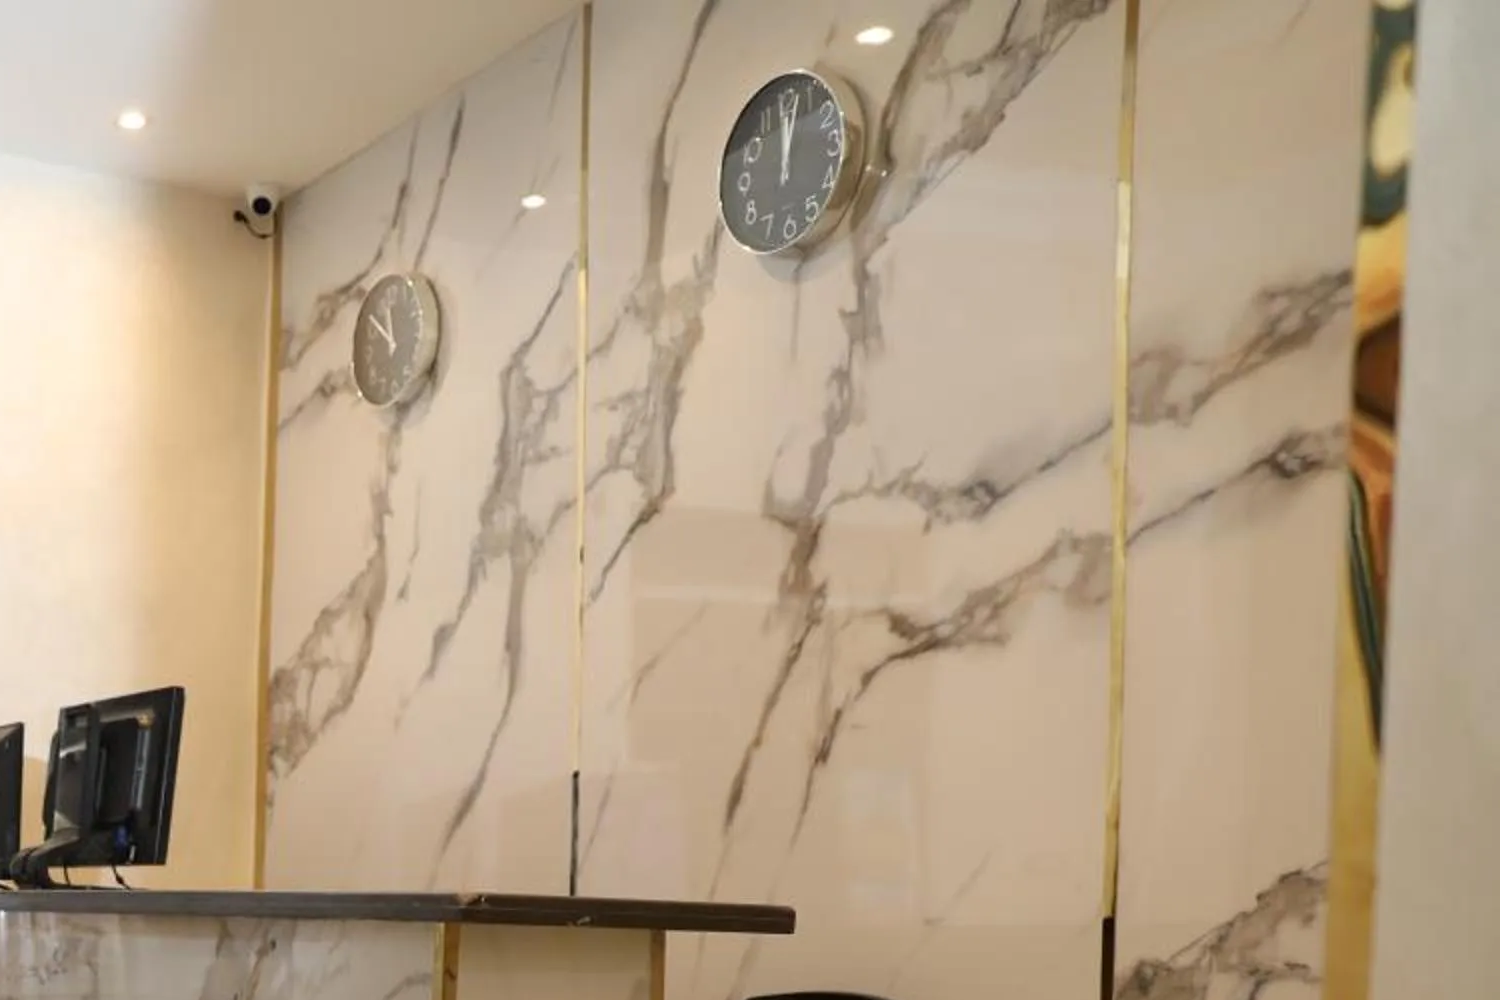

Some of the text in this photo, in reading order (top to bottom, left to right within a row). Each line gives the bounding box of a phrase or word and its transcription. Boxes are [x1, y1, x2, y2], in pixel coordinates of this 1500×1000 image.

[820, 101, 835, 129] 2
[743, 135, 764, 165] 10
[826, 129, 842, 157] 3
[737, 171, 751, 197] 9
[822, 165, 835, 189] 4
[745, 200, 758, 225] 8
[805, 195, 820, 222] 5
[760, 213, 775, 240] 7
[783, 214, 797, 239] 6
